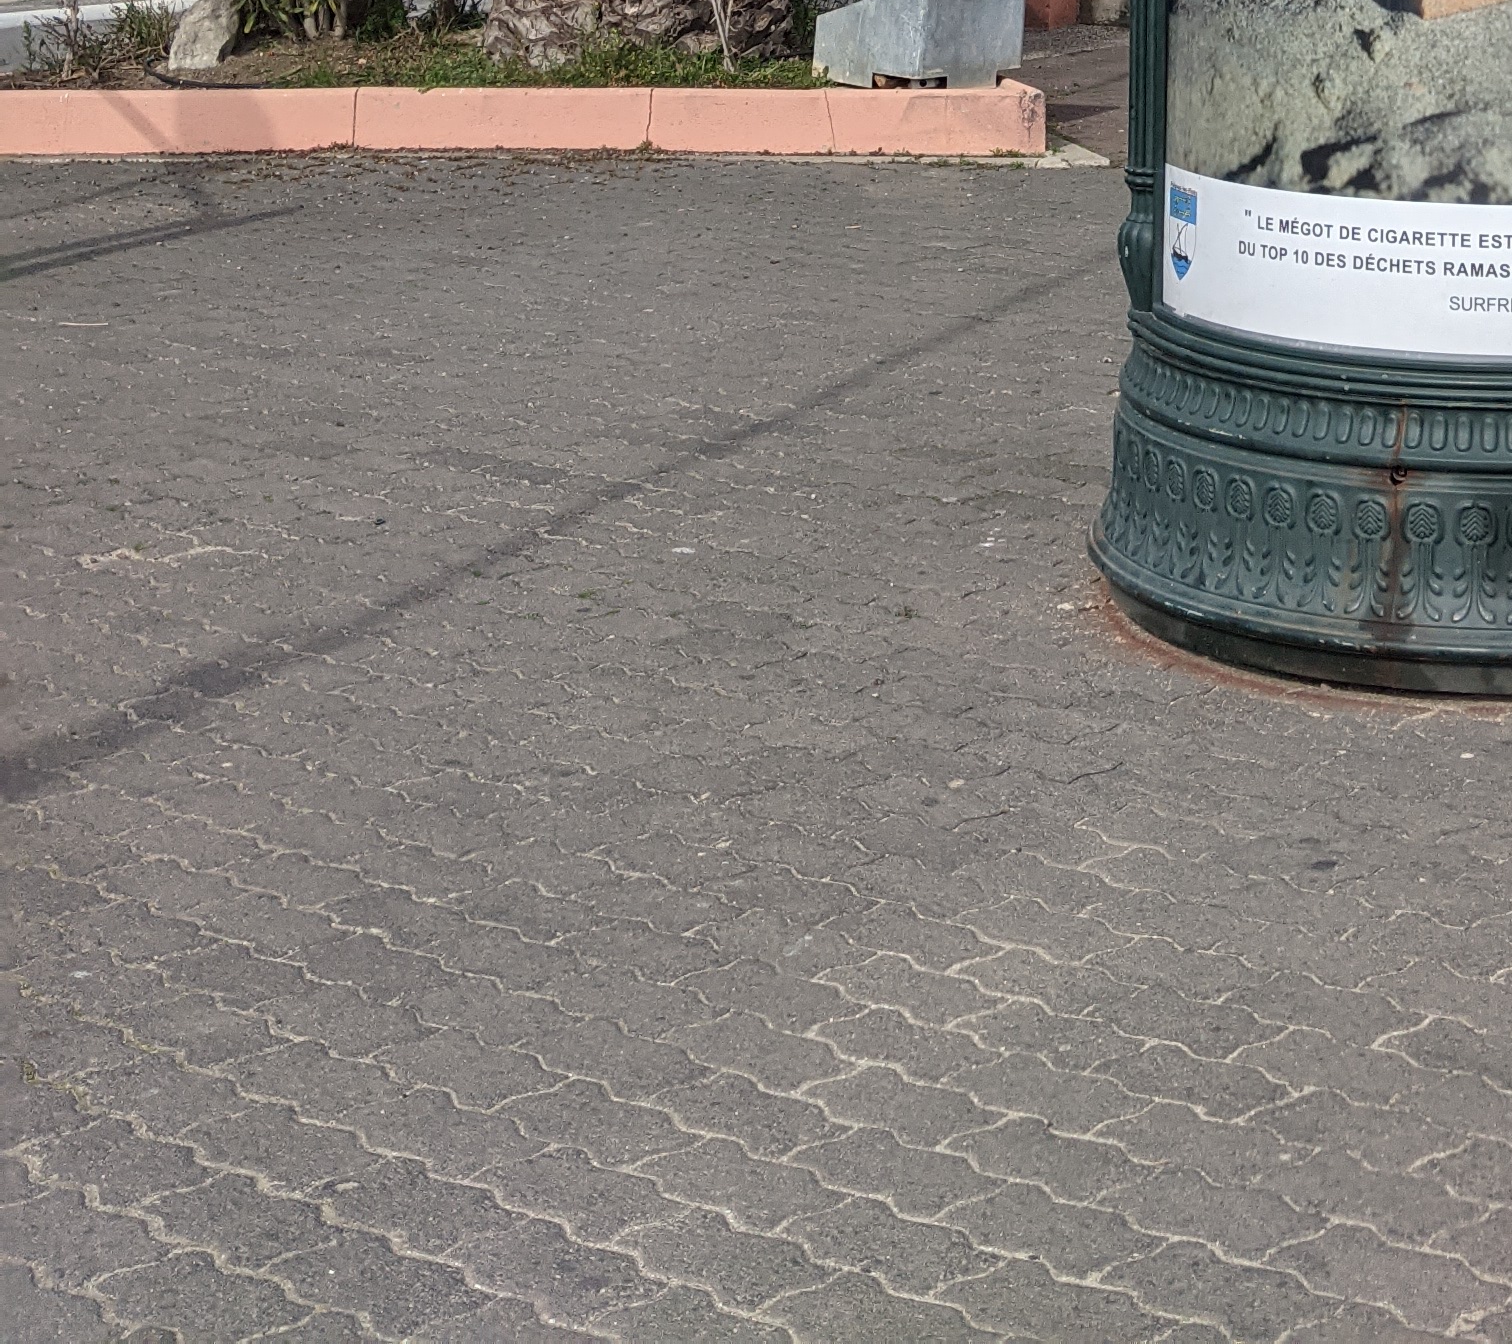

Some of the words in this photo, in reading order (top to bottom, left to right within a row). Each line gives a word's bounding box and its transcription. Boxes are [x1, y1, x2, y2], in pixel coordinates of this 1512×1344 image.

[1257, 215, 1274, 232] LE
[1278, 217, 1333, 239] MÉGOT
[1339, 225, 1362, 242] DE
[1367, 227, 1472, 249] CIGARETTE
[1238, 240, 1256, 257] DU
[1260, 244, 1288, 262] TOP
[1293, 249, 1309, 265] 10
[1314, 251, 1347, 269] DES
[1352, 253, 1436, 276] DÉCHETS
